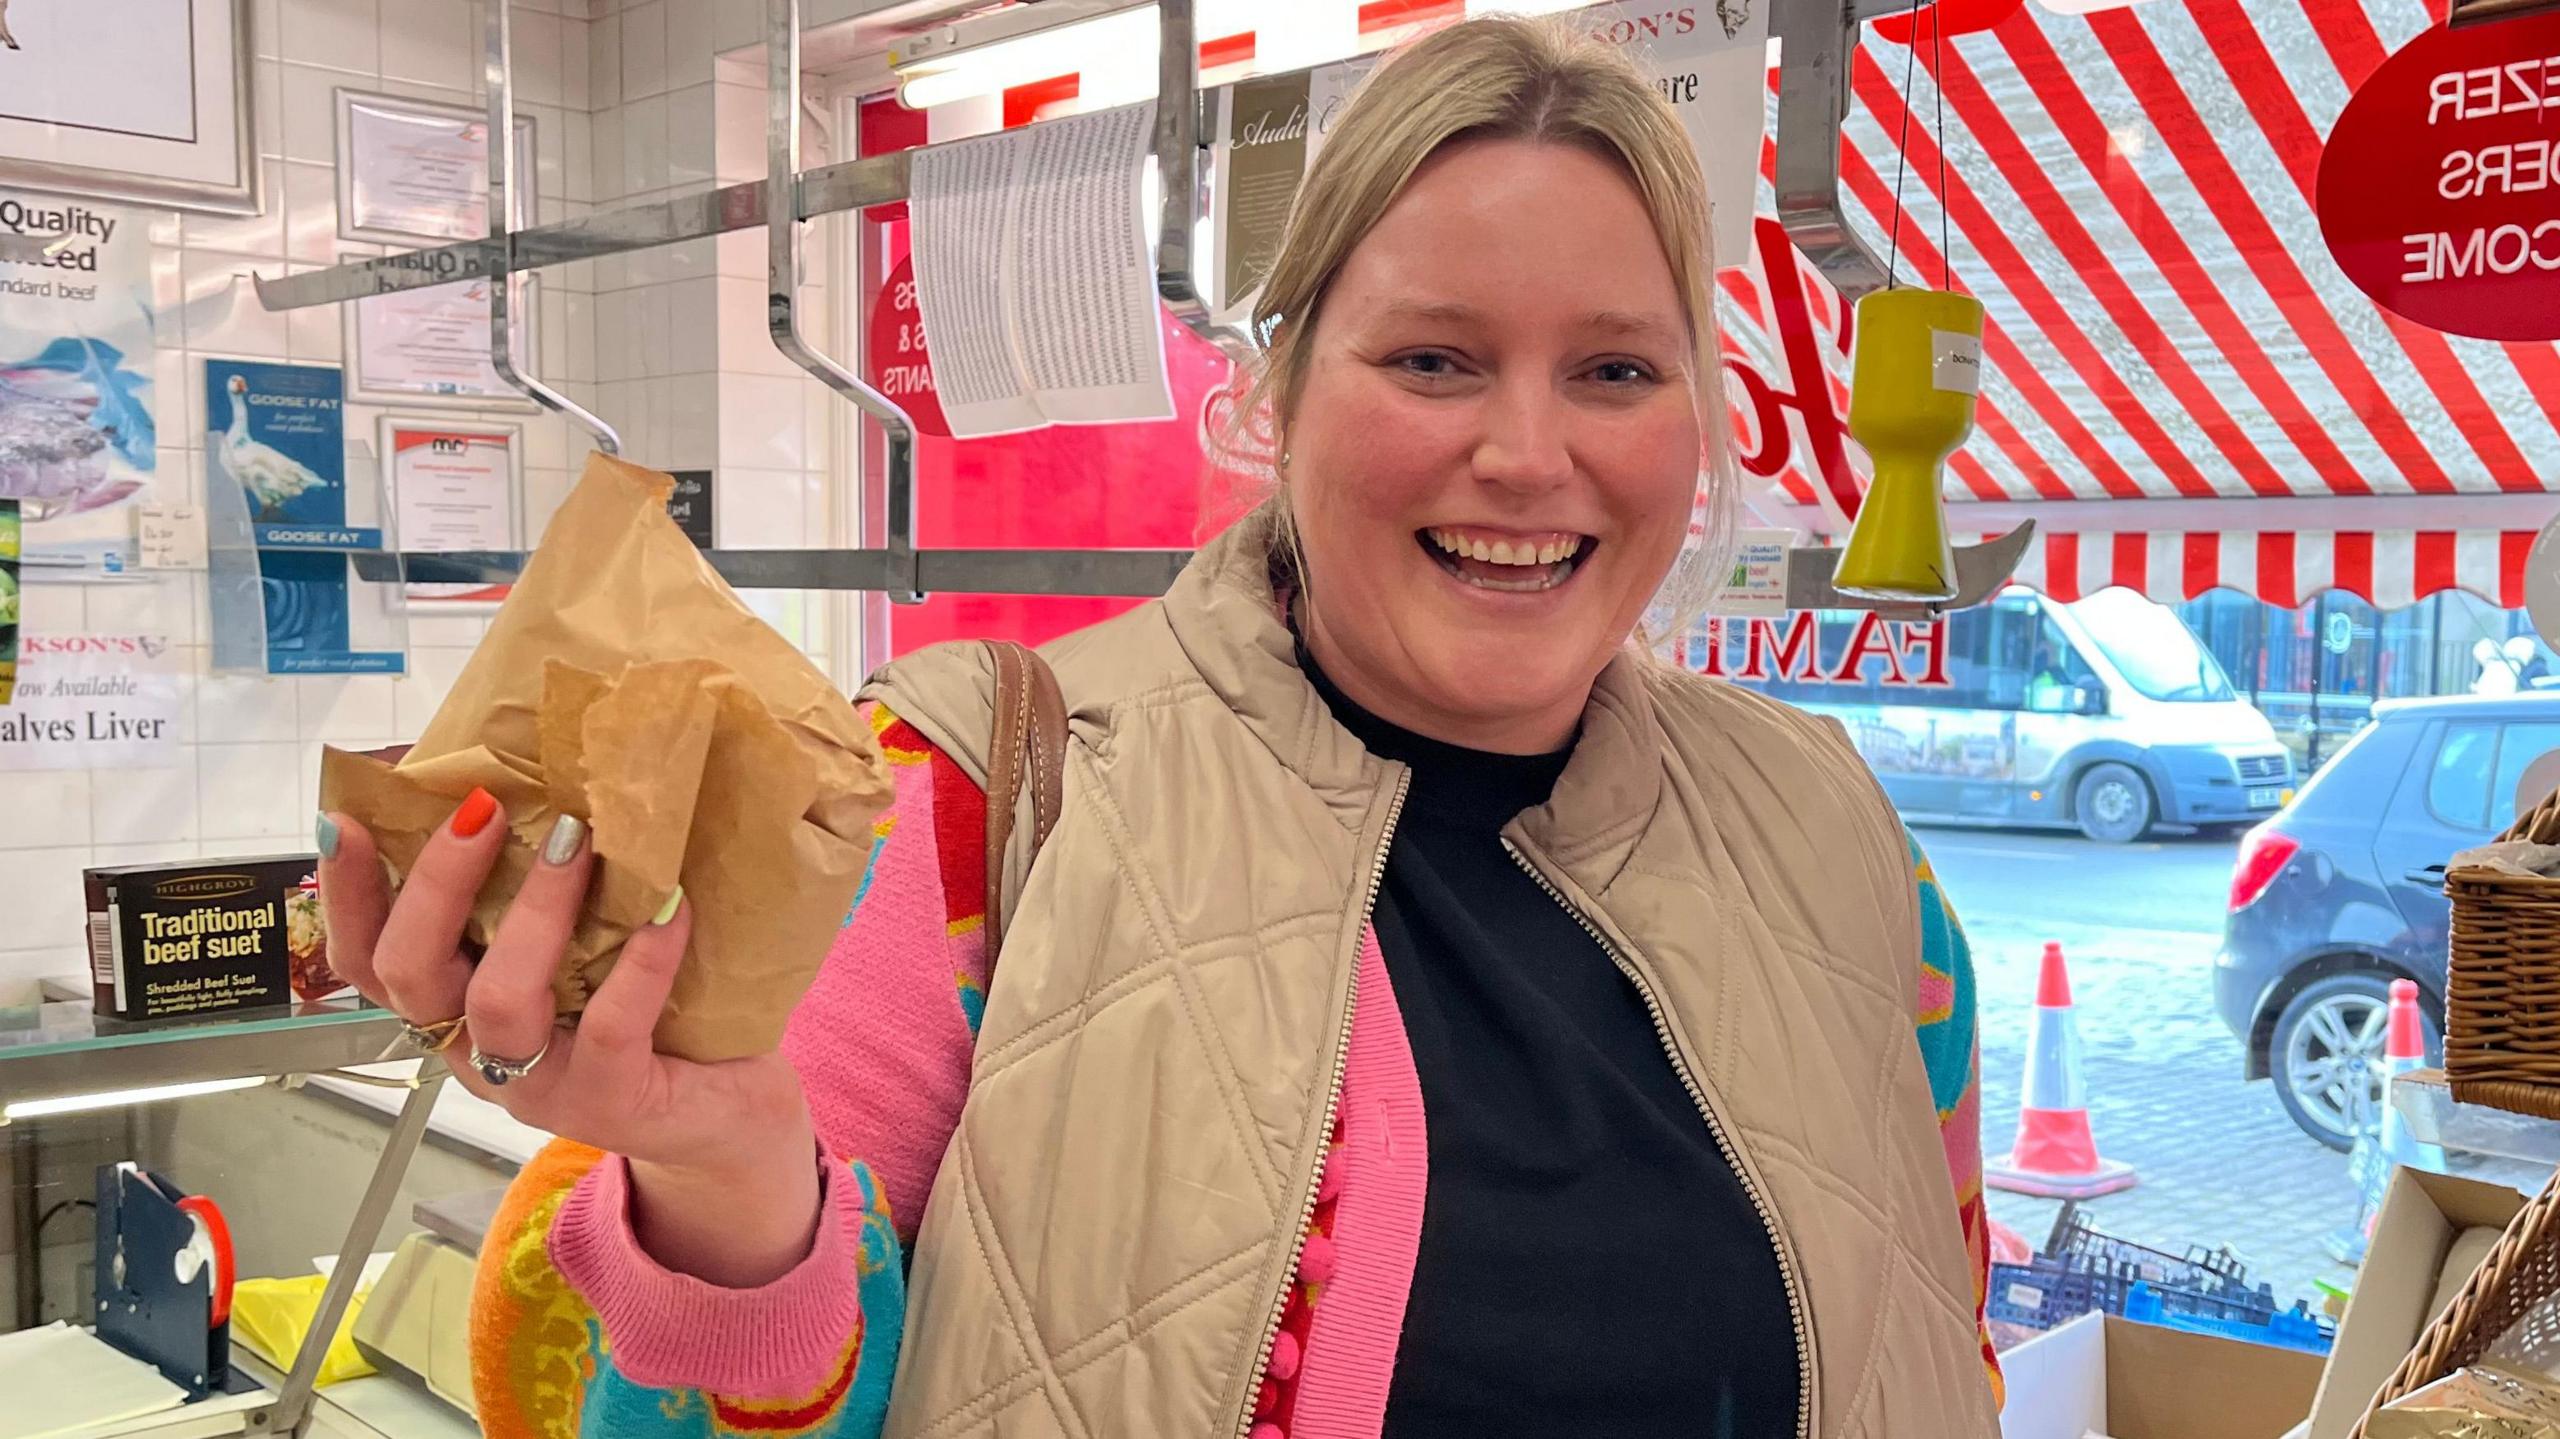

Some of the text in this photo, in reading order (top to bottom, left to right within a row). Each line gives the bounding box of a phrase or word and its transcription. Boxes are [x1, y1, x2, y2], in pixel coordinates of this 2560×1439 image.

[1230, 104, 1309, 150] Audit
[0, 200, 116, 243] Quality
[248, 394, 338, 410] GOOSE FAT
[267, 530, 360, 544] GOOSE FAT
[50, 675, 137, 698] Available
[1, 710, 166, 742] alves Liver
[140, 902, 275, 939] Traditional
[143, 934, 201, 965] beef
[206, 930, 262, 959] suet
[146, 974, 256, 996] Shredded Beef Suet
